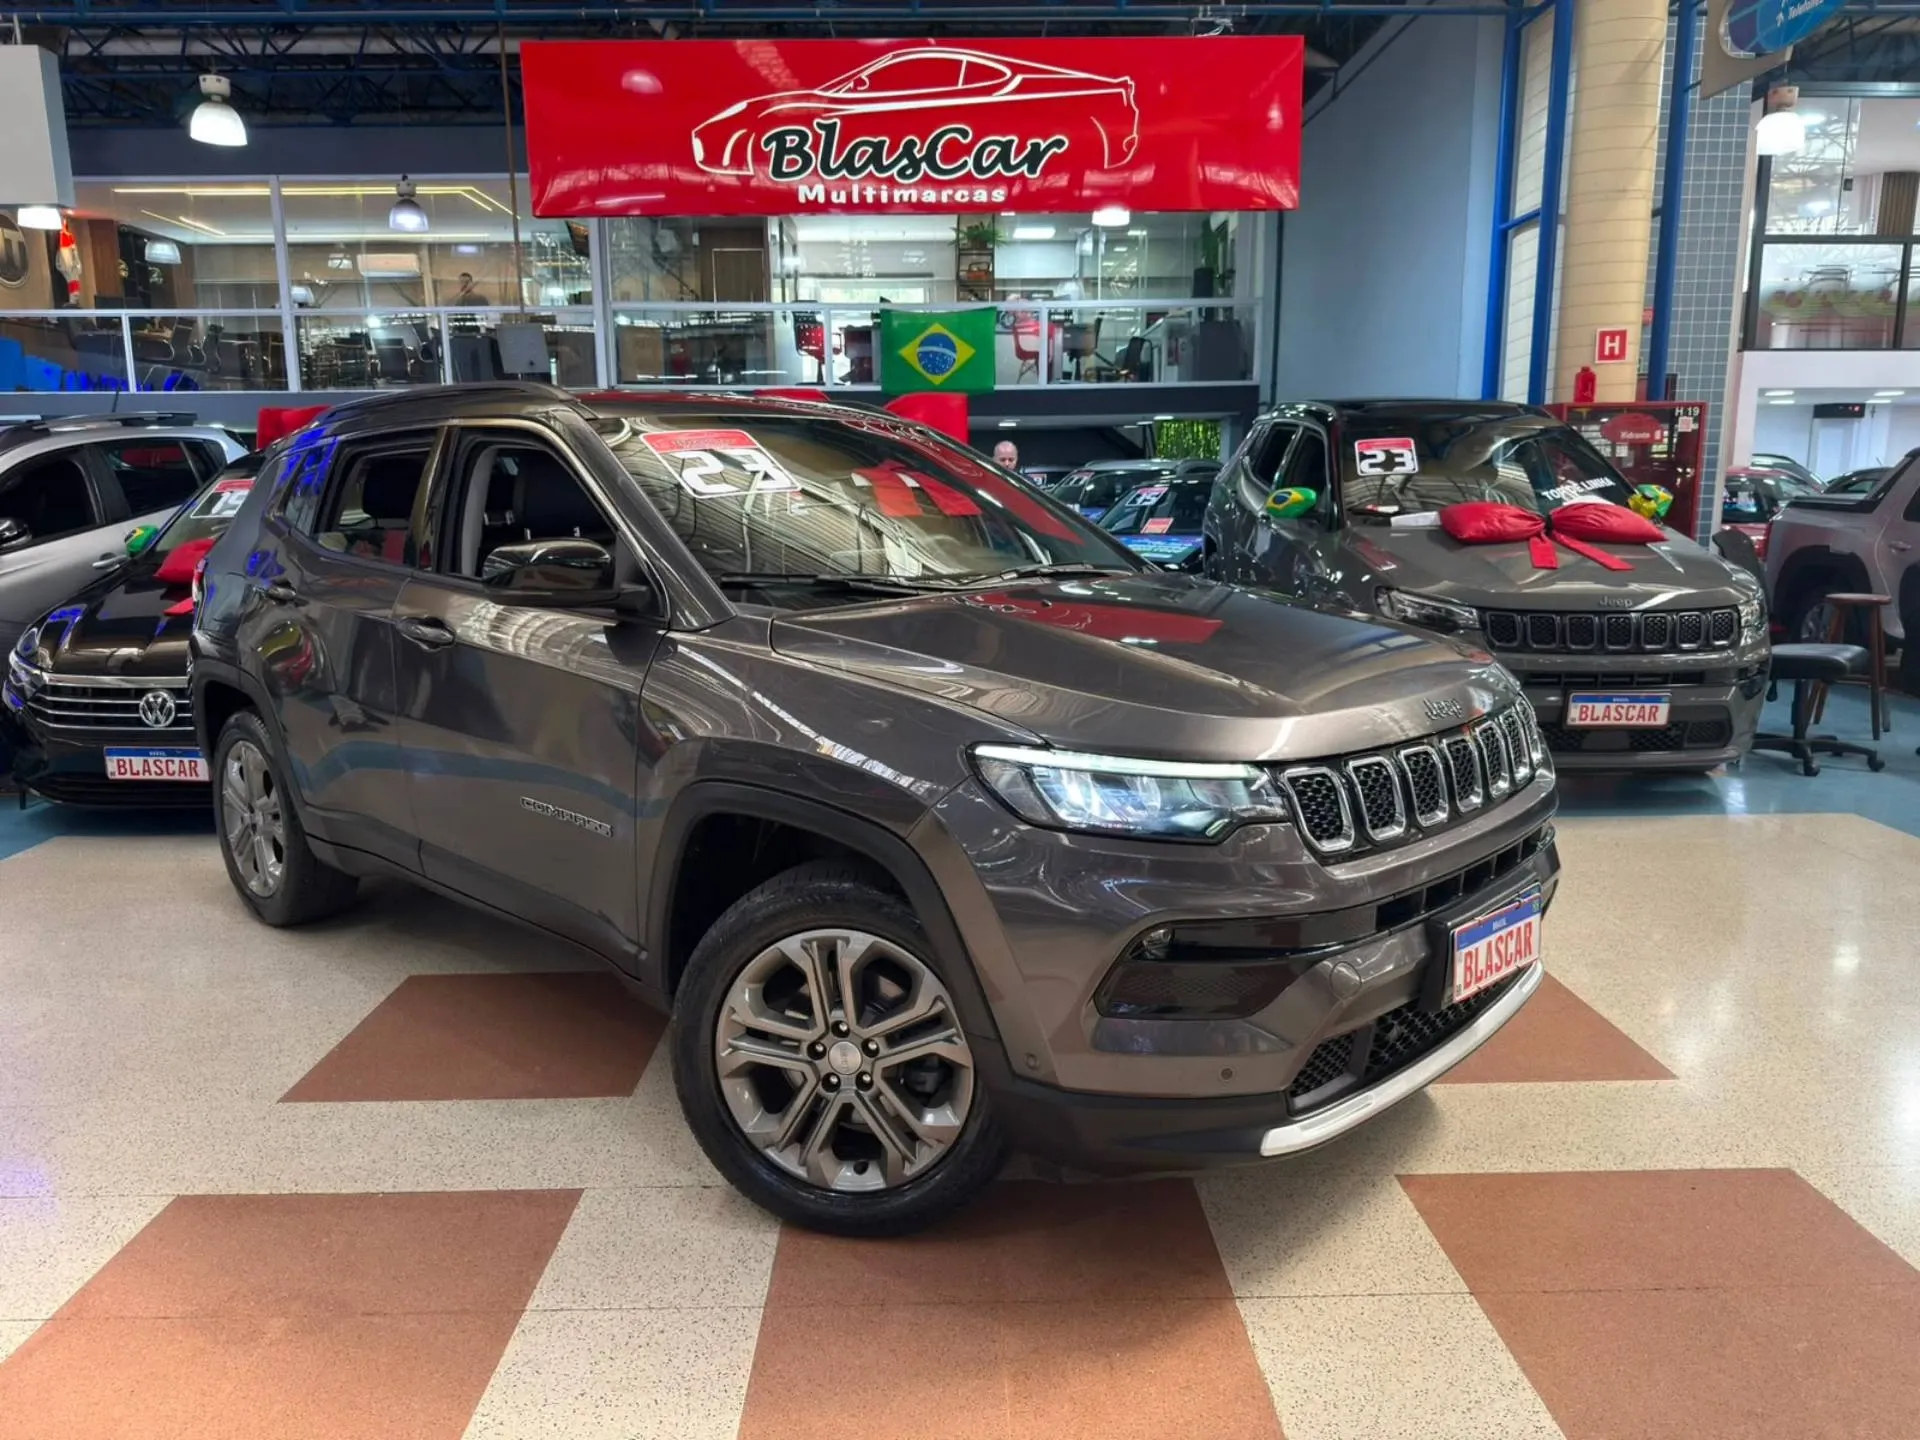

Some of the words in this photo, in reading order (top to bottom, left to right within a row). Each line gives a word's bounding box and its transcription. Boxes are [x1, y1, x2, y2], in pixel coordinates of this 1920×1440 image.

[762, 118, 1068, 183] BlasCar
[798, 184, 1006, 204] Multimarcas
[1604, 335, 1620, 356] H
[1360, 449, 1415, 474] 23
[1578, 704, 1659, 722] BLASCAR
[116, 758, 200, 778] BLASCAR
[1463, 921, 1533, 989] BLASCAR
